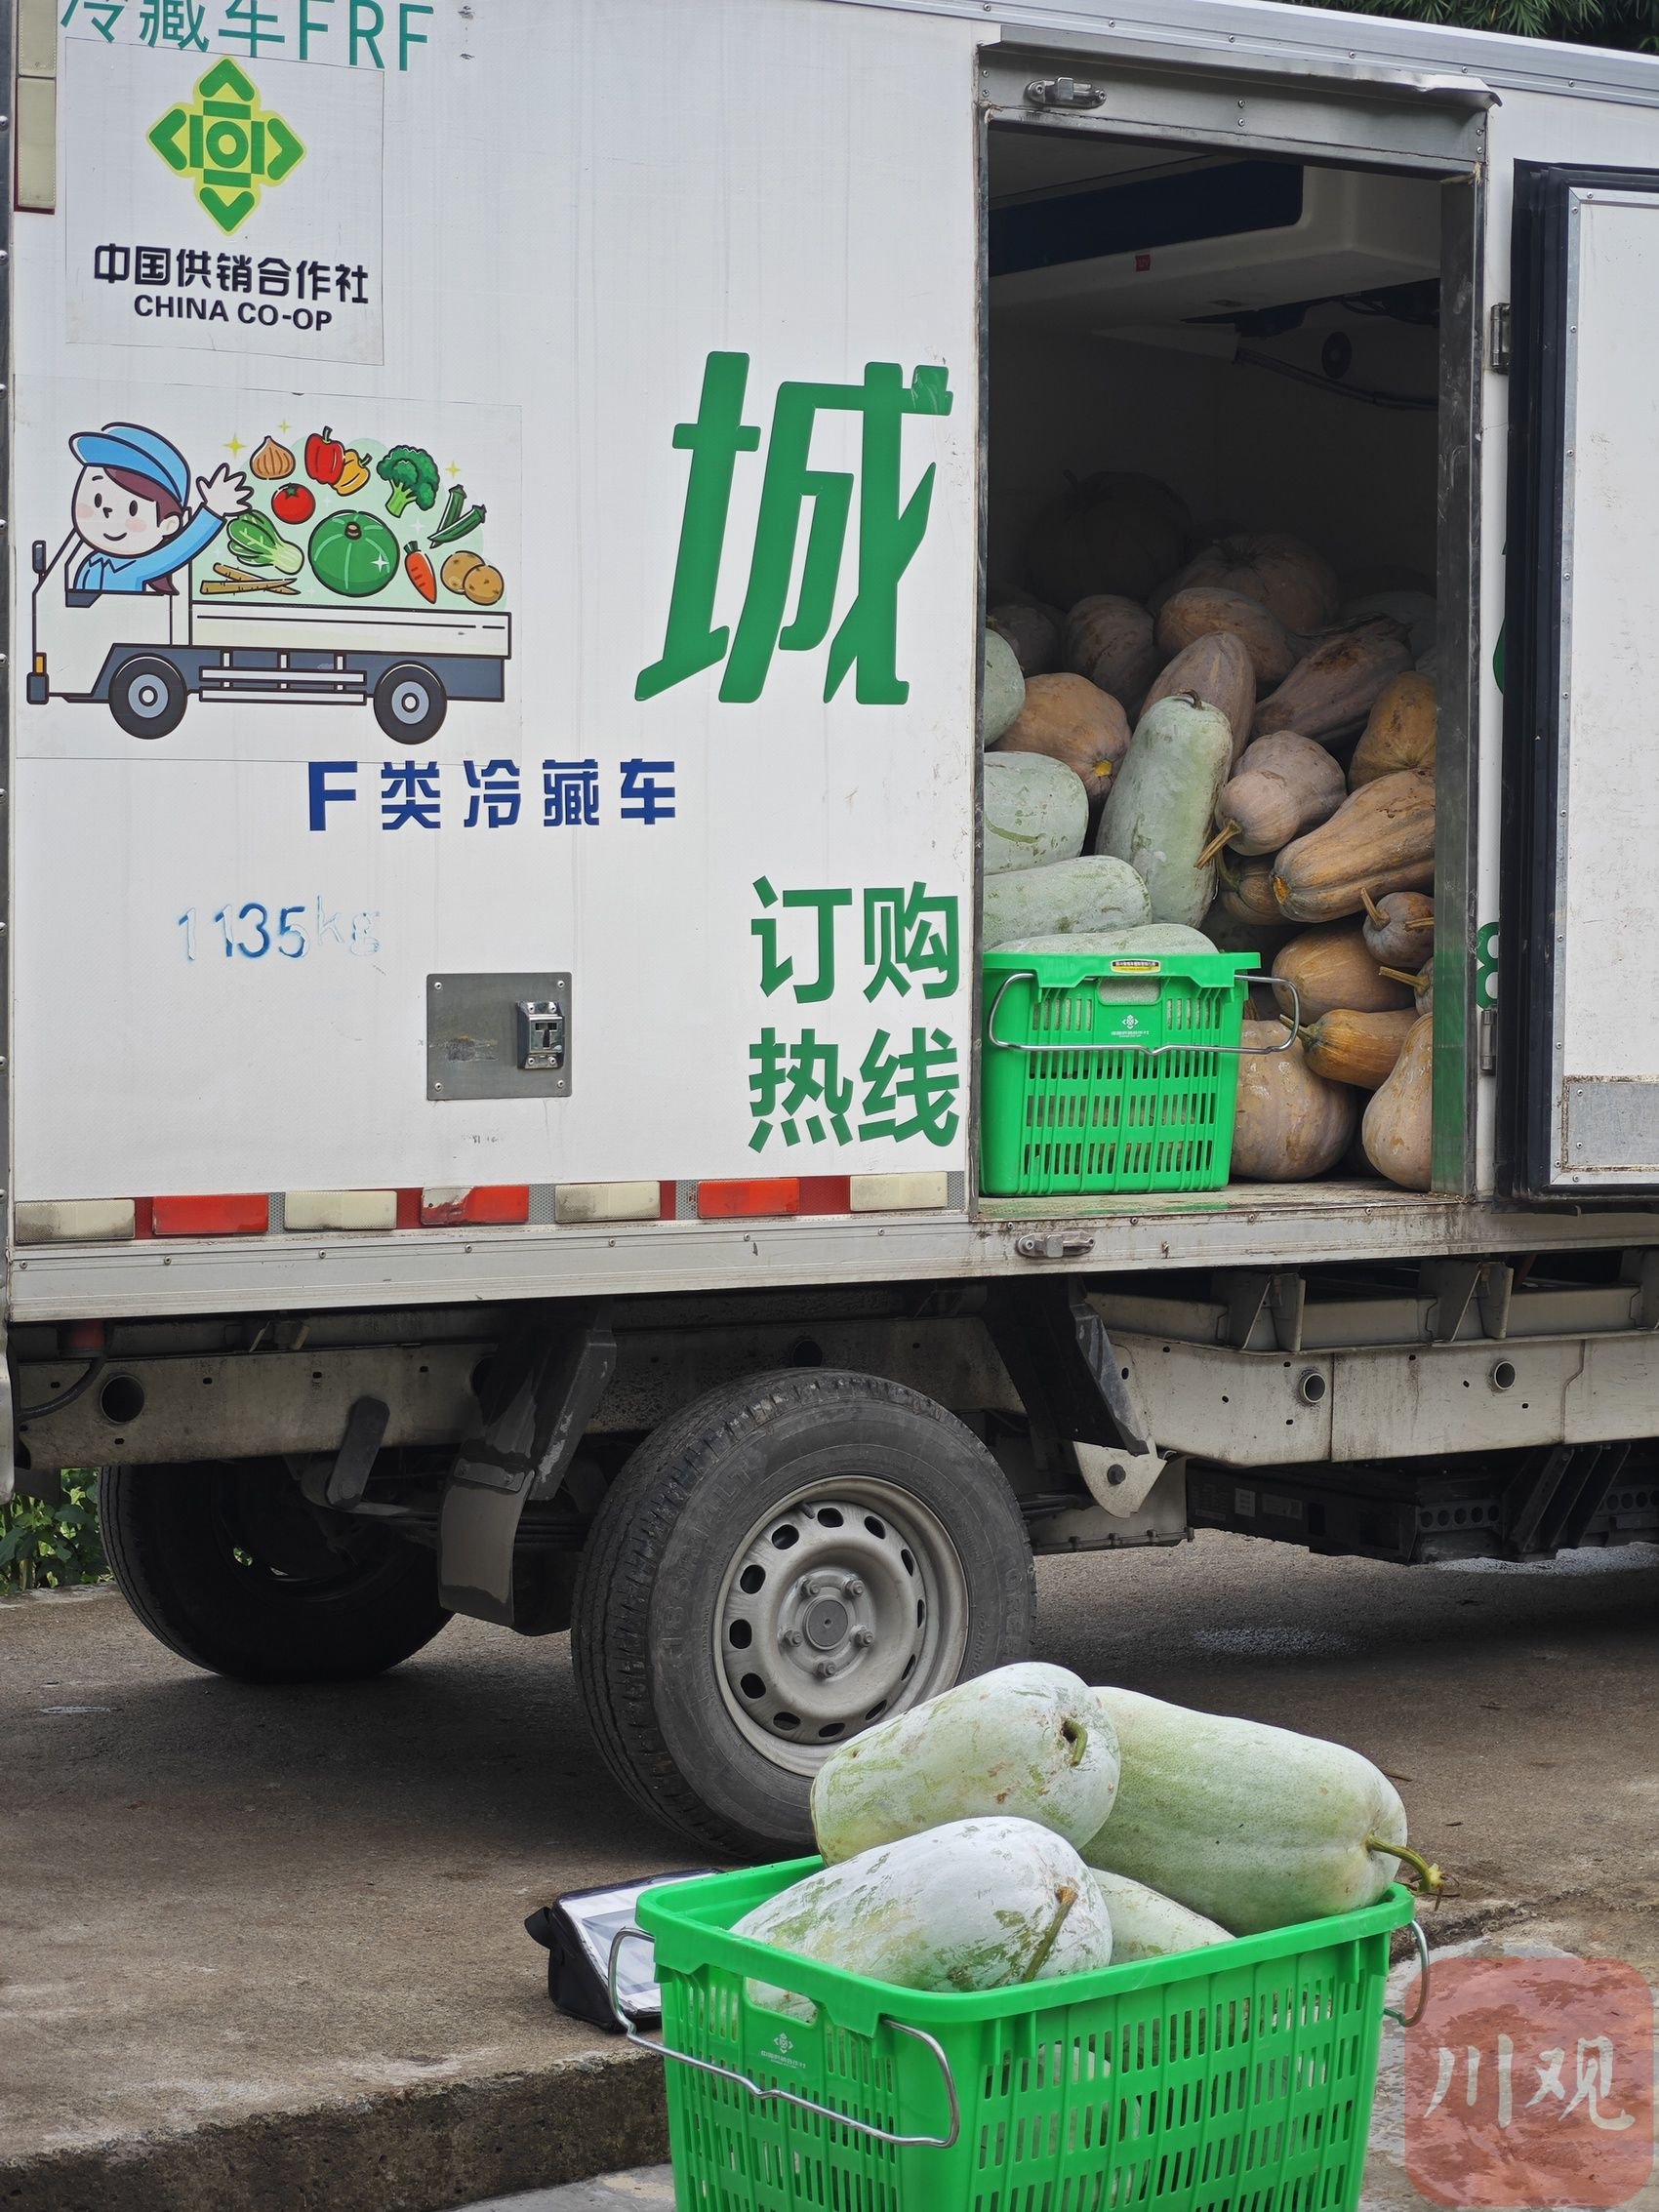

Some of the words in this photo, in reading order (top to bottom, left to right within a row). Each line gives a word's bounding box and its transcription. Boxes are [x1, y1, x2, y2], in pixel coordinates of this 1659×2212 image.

[95, 243, 369, 304] 中国供销合作社
[134, 294, 229, 322] CHINA
[237, 302, 333, 332] CO-OP
[634, 351, 953, 704] 城
[751, 875, 959, 1004] 订购
[748, 1026, 959, 1153] 热线
